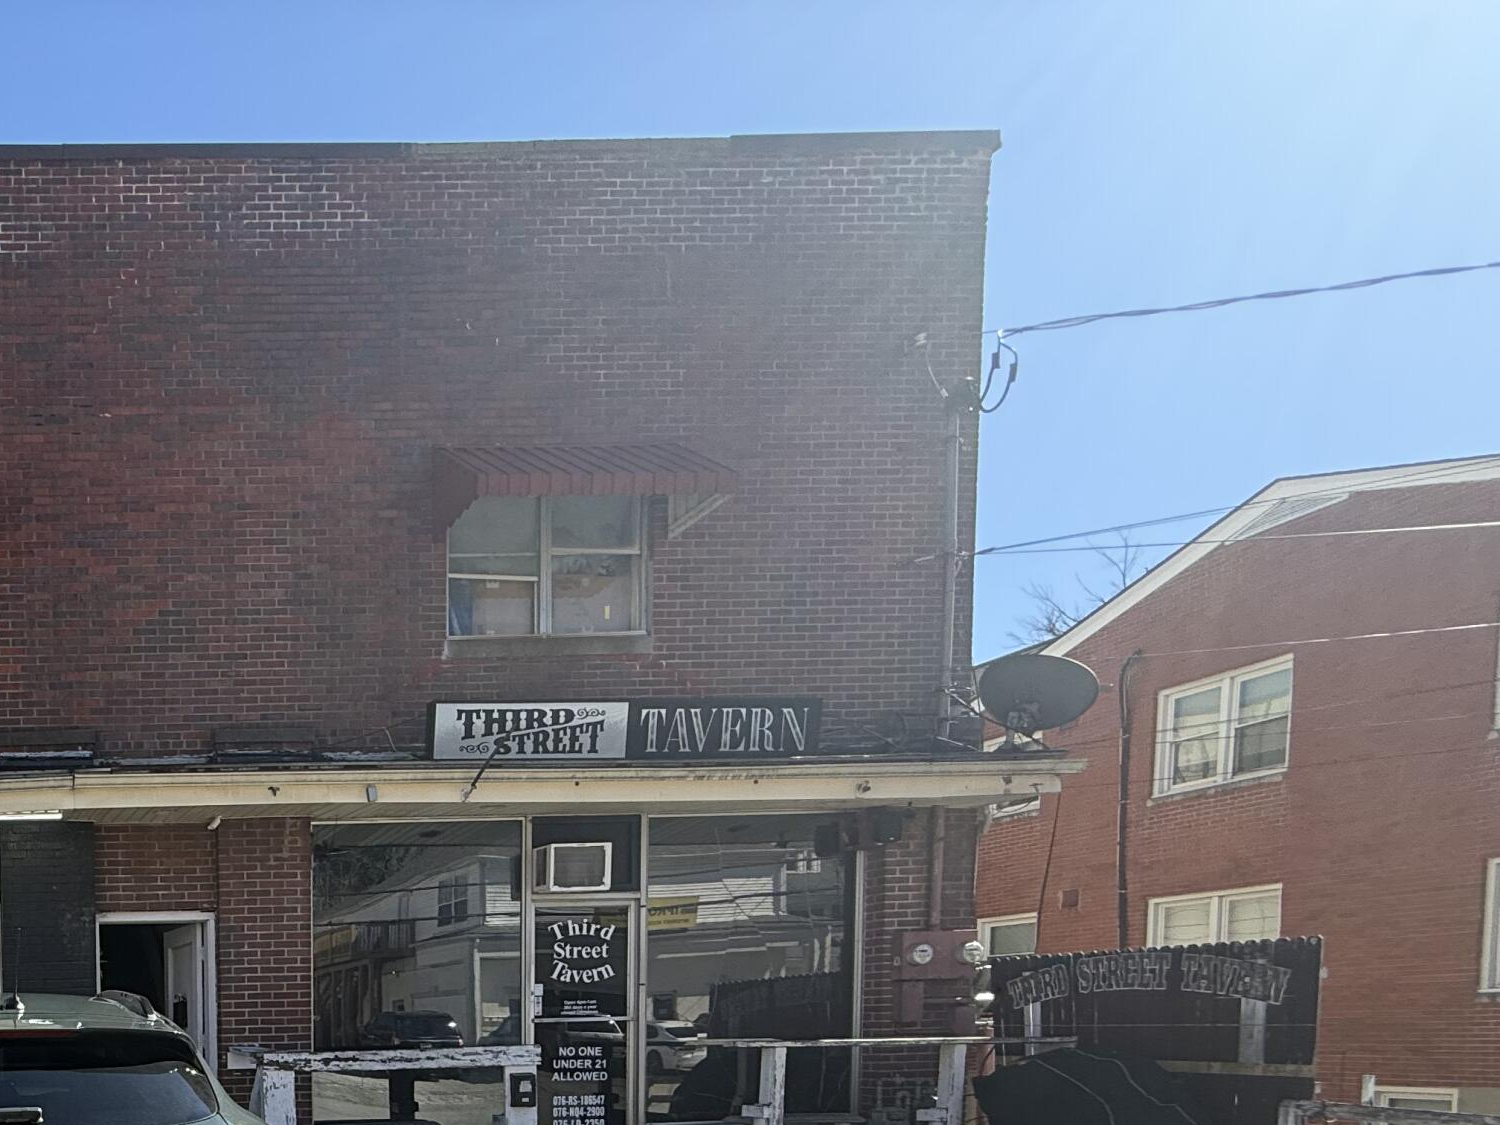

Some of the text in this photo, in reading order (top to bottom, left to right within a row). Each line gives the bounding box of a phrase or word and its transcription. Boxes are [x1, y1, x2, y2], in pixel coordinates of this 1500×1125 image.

[457, 708, 577, 741] THIRD
[641, 707, 809, 753] TAVERN
[492, 719, 605, 755] STREET
[547, 918, 616, 941] Third
[553, 941, 609, 959] Street
[550, 960, 616, 984] Tavern
[1007, 952, 1292, 1009] THIRD STREET TAVERN
[559, 1046, 603, 1056] NO ONE
[553, 1059, 607, 1069] UNDER 21
[551, 1071, 608, 1081] ALLOWED
